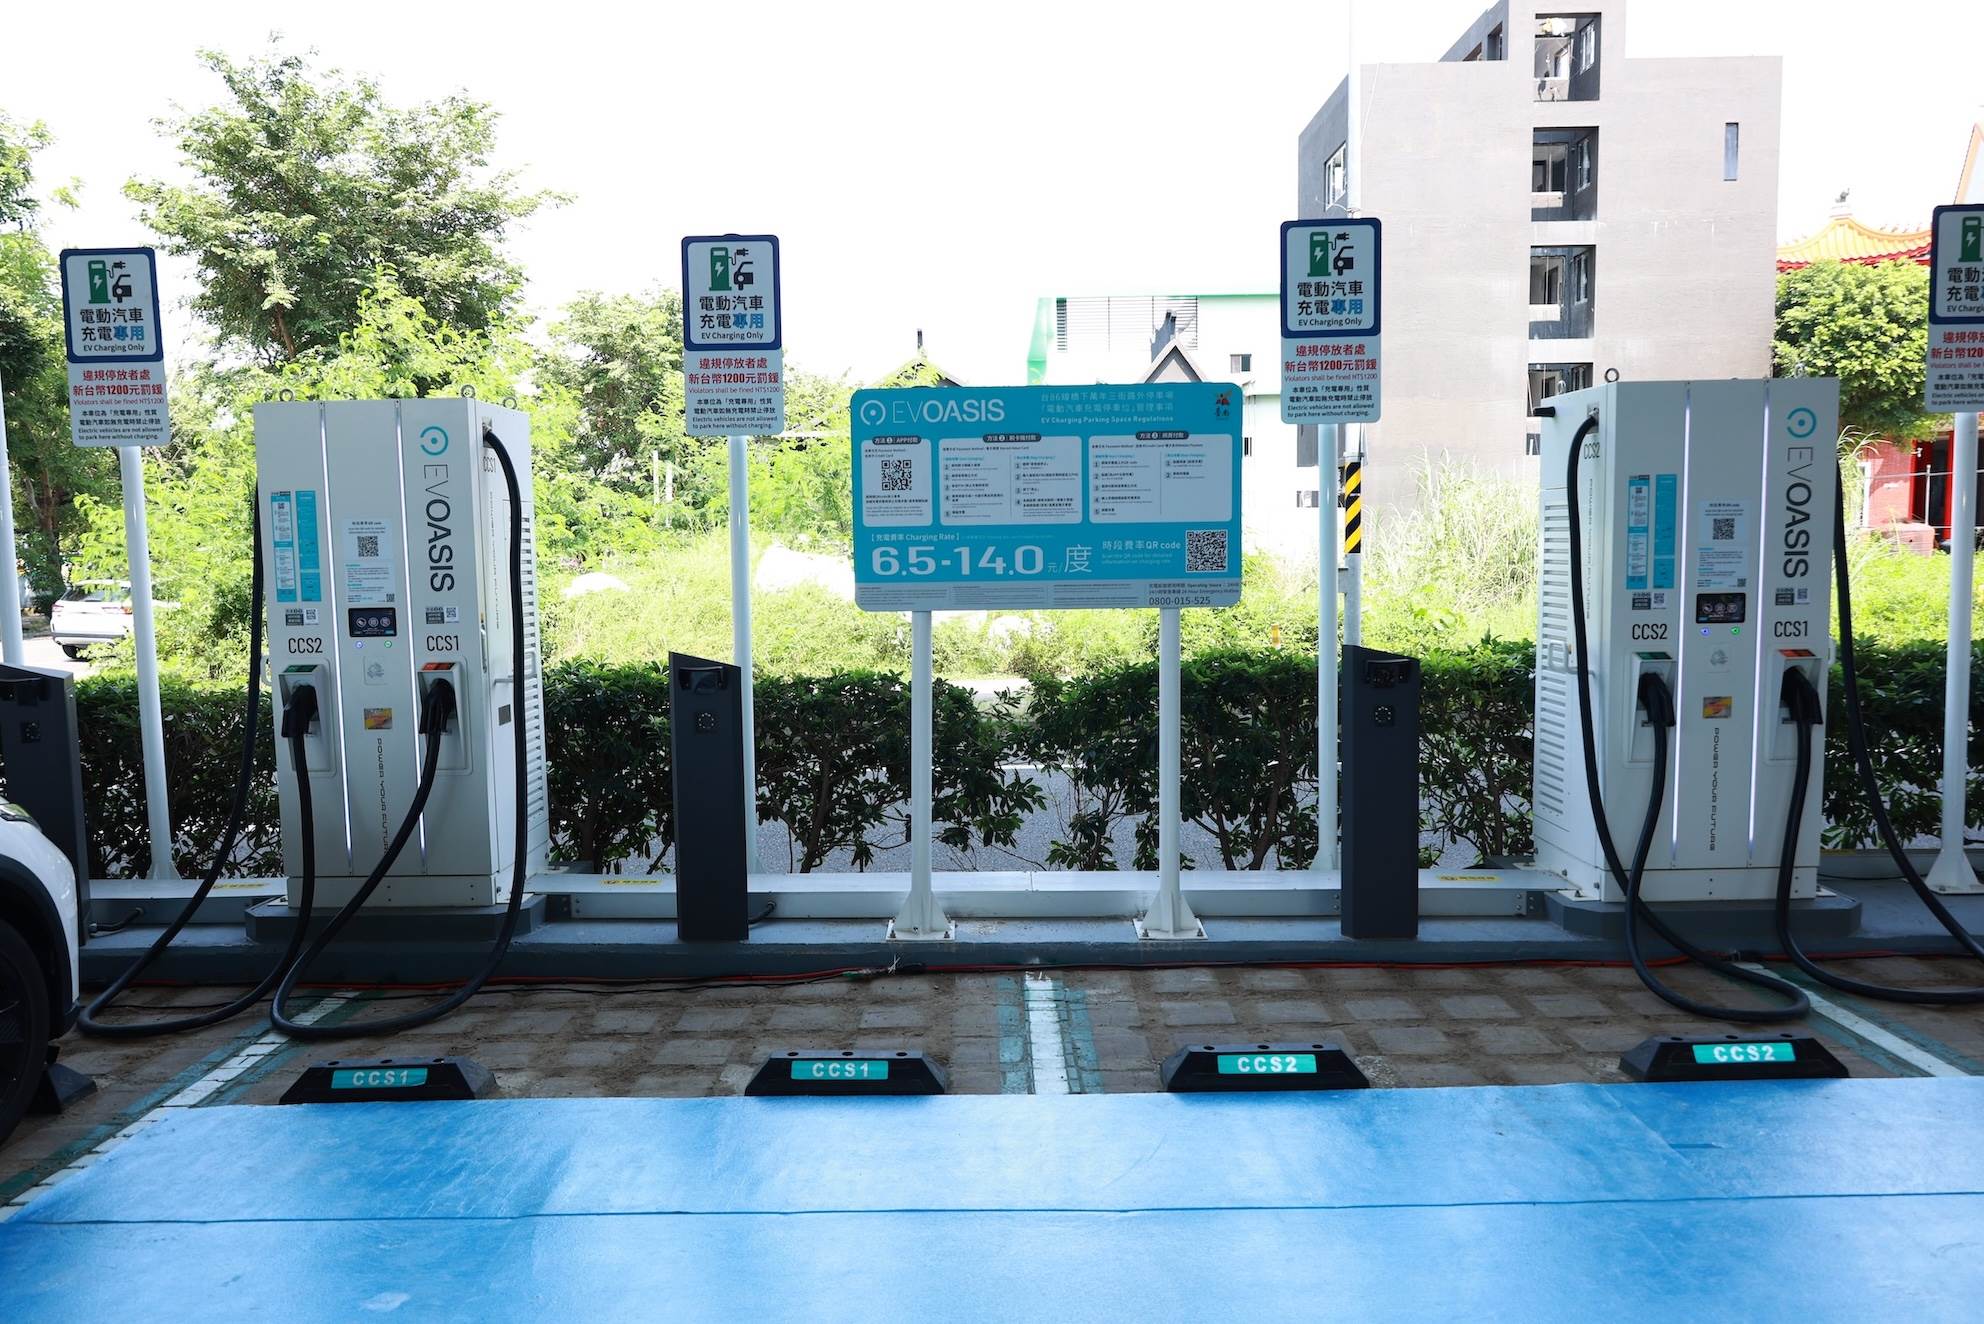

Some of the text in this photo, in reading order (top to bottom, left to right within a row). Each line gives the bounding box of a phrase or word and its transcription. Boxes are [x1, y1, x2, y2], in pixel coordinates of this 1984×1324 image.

[1948, 267, 1984, 283] 電動
[1297, 281, 1363, 297] 電動汽車
[1947, 286, 1984, 302] 充電
[699, 296, 763, 311] 電動汽車
[1297, 299, 1363, 316] 充電專用
[80, 308, 144, 323] 電動汽車
[700, 313, 764, 329] 充電專用
[1309, 319, 1343, 328] Charging
[1345, 318, 1362, 327] Only
[82, 326, 144, 341] 充電專用
[712, 331, 745, 341] Charging
[747, 331, 763, 341] Only
[94, 344, 126, 353] Charging
[128, 343, 144, 352] Only
[1296, 344, 1365, 356] 違規停放者處
[699, 358, 767, 369] 違規停放者處
[83, 369, 150, 380] 違規停放者處
[892, 399, 1005, 423] EVOASIS
[1051, 416, 1082, 424] Charging
[1783, 446, 1813, 579] EVOASIS
[423, 464, 455, 592] EVOASIS
[1161, 540, 1181, 549] code
[1632, 623, 1668, 640] CCS2
[1774, 621, 1808, 637] CCS1
[288, 637, 323, 654] CCS2
[426, 635, 459, 651] CCS1
[1709, 806, 1717, 851] FUTURE
[1713, 1045, 1775, 1062] CCS2
[812, 1062, 868, 1077] CCS1
[1237, 1056, 1297, 1072] CCS2
[352, 1070, 408, 1086] CCS1
